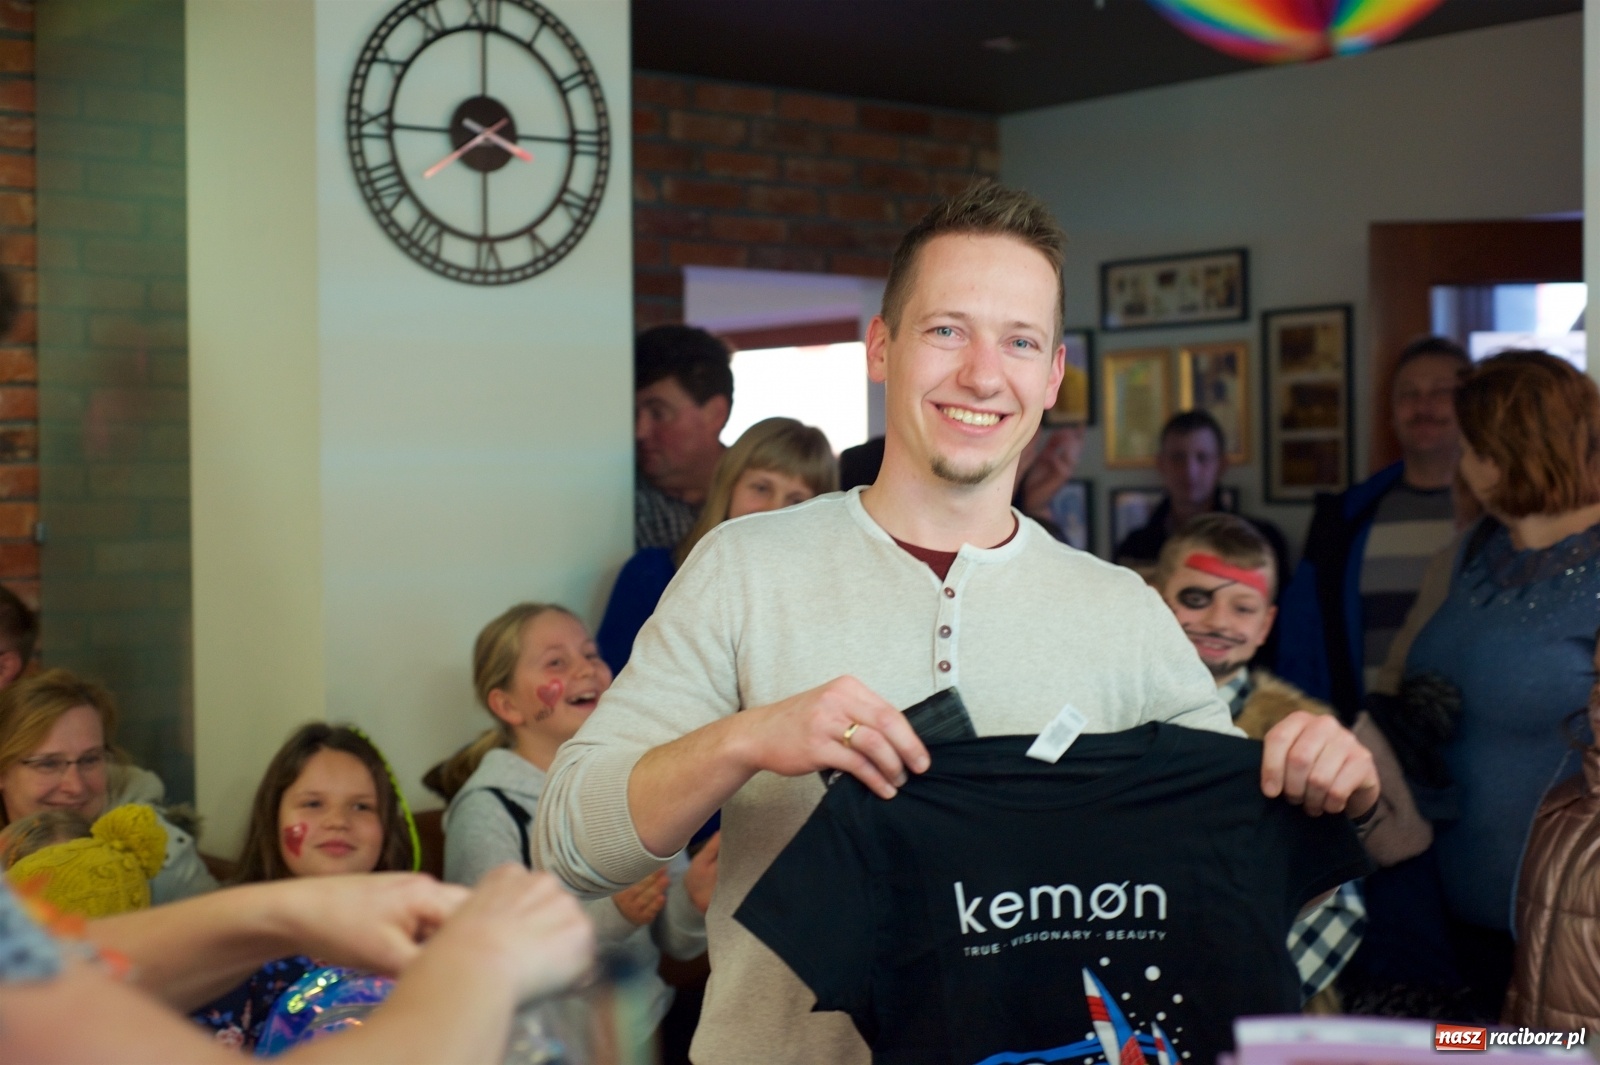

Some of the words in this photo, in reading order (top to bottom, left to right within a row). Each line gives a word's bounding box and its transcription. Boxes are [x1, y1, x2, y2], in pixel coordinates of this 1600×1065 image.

[954, 880, 1167, 935] kemøn
[963, 942, 1001, 957] TRUE
[1010, 930, 1092, 948] VISIONARY
[1105, 930, 1167, 941] BEAUTY
